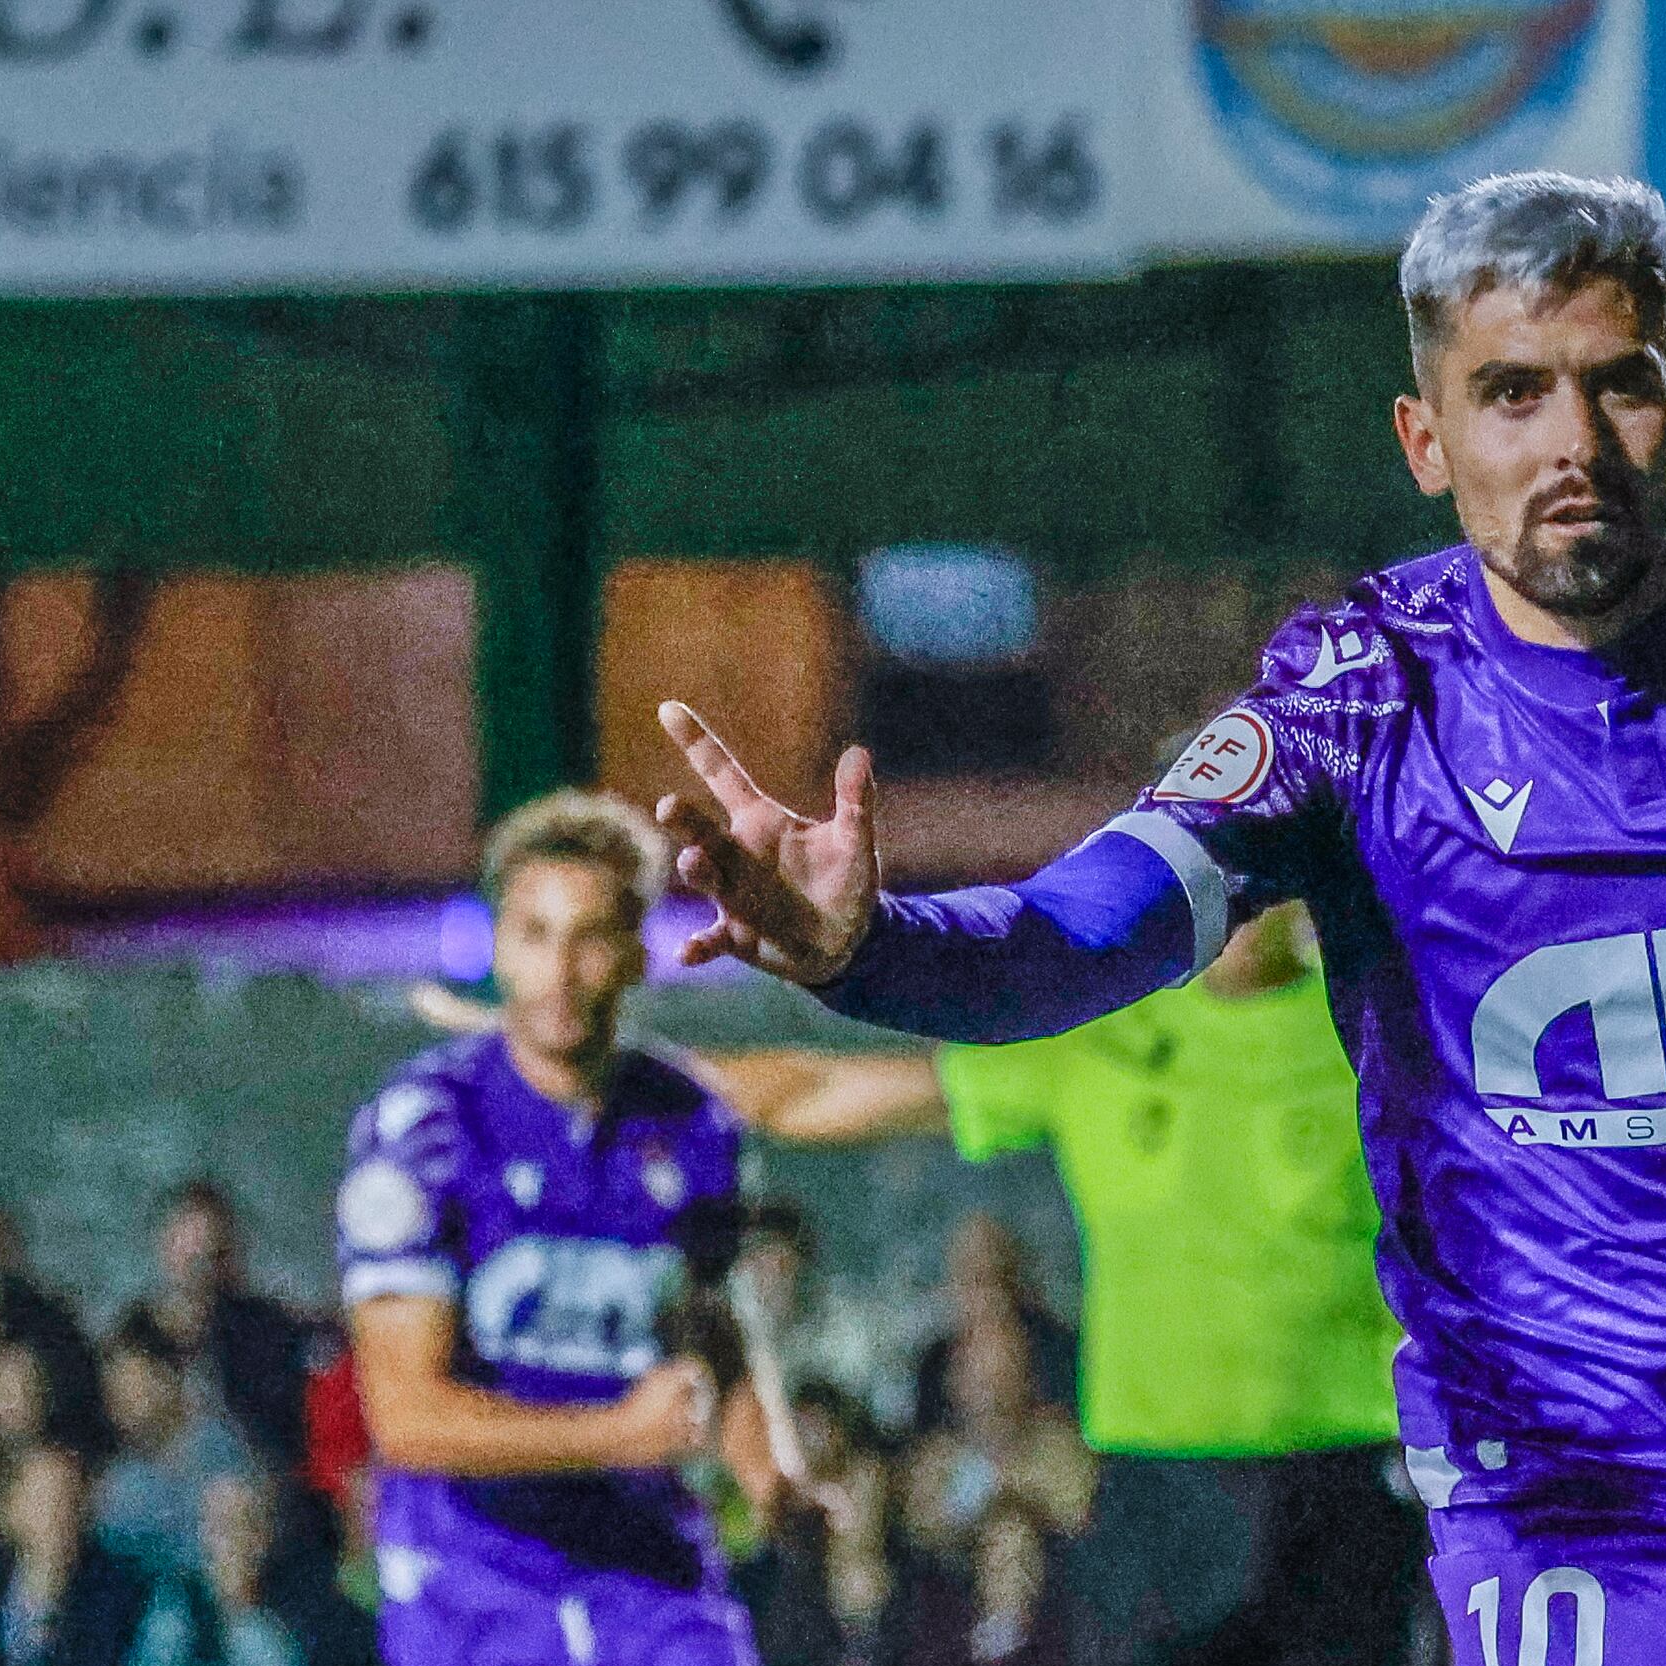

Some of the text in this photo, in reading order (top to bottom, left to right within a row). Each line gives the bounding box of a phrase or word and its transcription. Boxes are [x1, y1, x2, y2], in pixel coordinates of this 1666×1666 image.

[405, 115, 597, 238] 615
[621, 115, 777, 238] 99
[793, 112, 951, 228] 04
